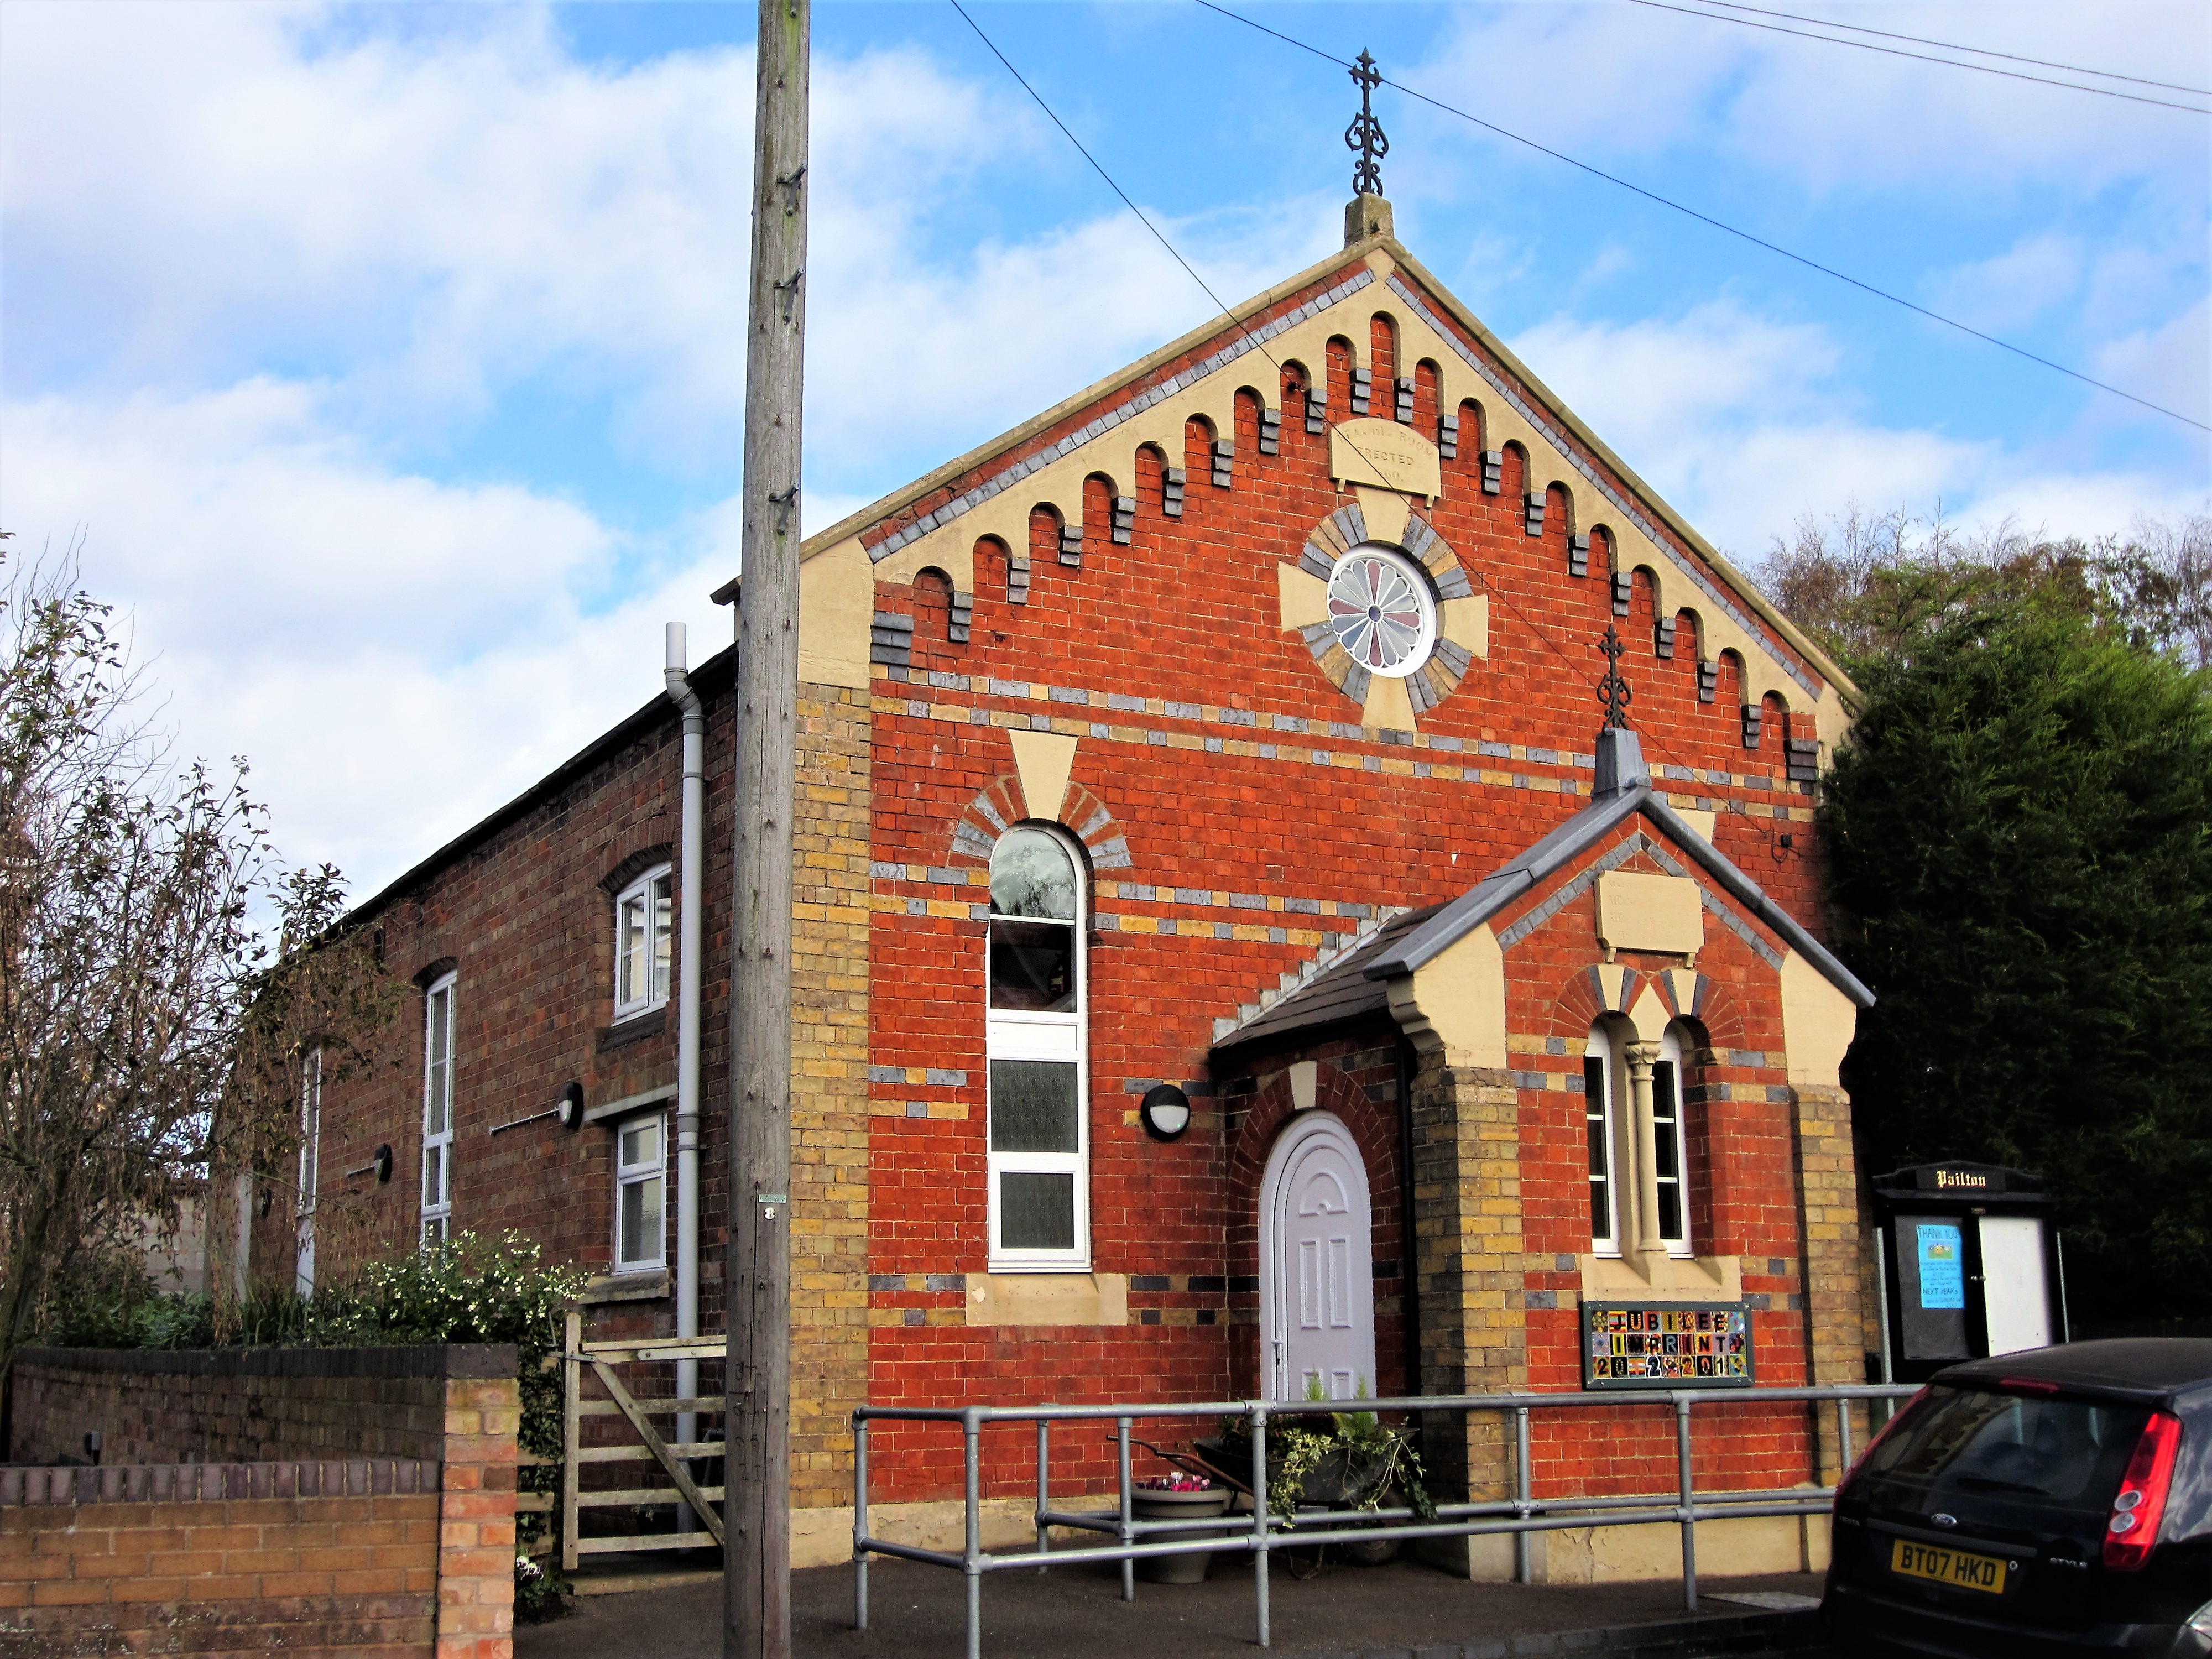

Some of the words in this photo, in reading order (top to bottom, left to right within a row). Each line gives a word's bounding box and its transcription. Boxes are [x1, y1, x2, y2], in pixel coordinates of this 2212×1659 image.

[1357, 446, 1415, 466] ERECTED
[1936, 1170, 1986, 1188] Pailton
[1610, 1313, 1726, 1332] JUBILEE
[1616, 1335, 1725, 1354] IMPRINT
[1901, 1545, 1951, 1576] BT07
[1955, 1554, 1996, 1587] HKD
[2049, 1557, 2088, 1569] STYLE
